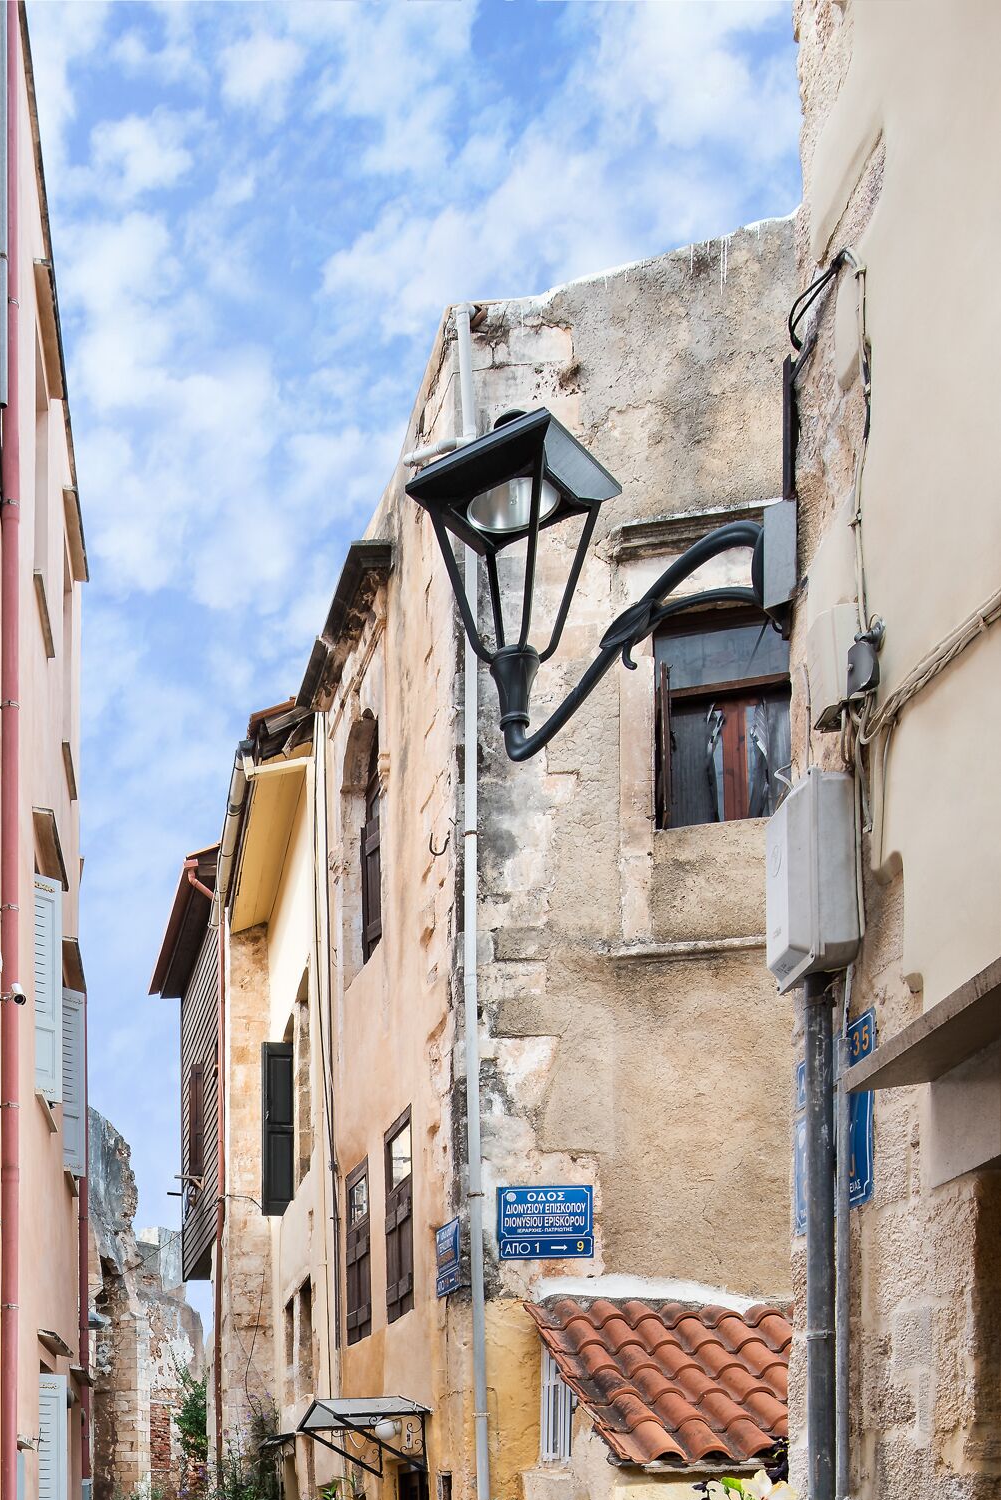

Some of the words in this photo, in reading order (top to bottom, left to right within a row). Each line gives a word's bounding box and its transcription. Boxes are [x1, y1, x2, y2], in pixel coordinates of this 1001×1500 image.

[853, 1025, 870, 1056] 35
[527, 1192, 566, 1201] ΟΔΟΣ
[505, 1203, 544, 1214] ΔΙΟΝΥΣΙΟΥ
[545, 1202, 586, 1213] ΕΠΙΣΚΟΠΟΥ
[504, 1216, 543, 1227] DIONYSIOU
[544, 1215, 585, 1226] EPISKOPOU
[504, 1243, 530, 1254] ΑΠΟ
[534, 1242, 540, 1253] 1
[576, 1241, 584, 1252] 9
